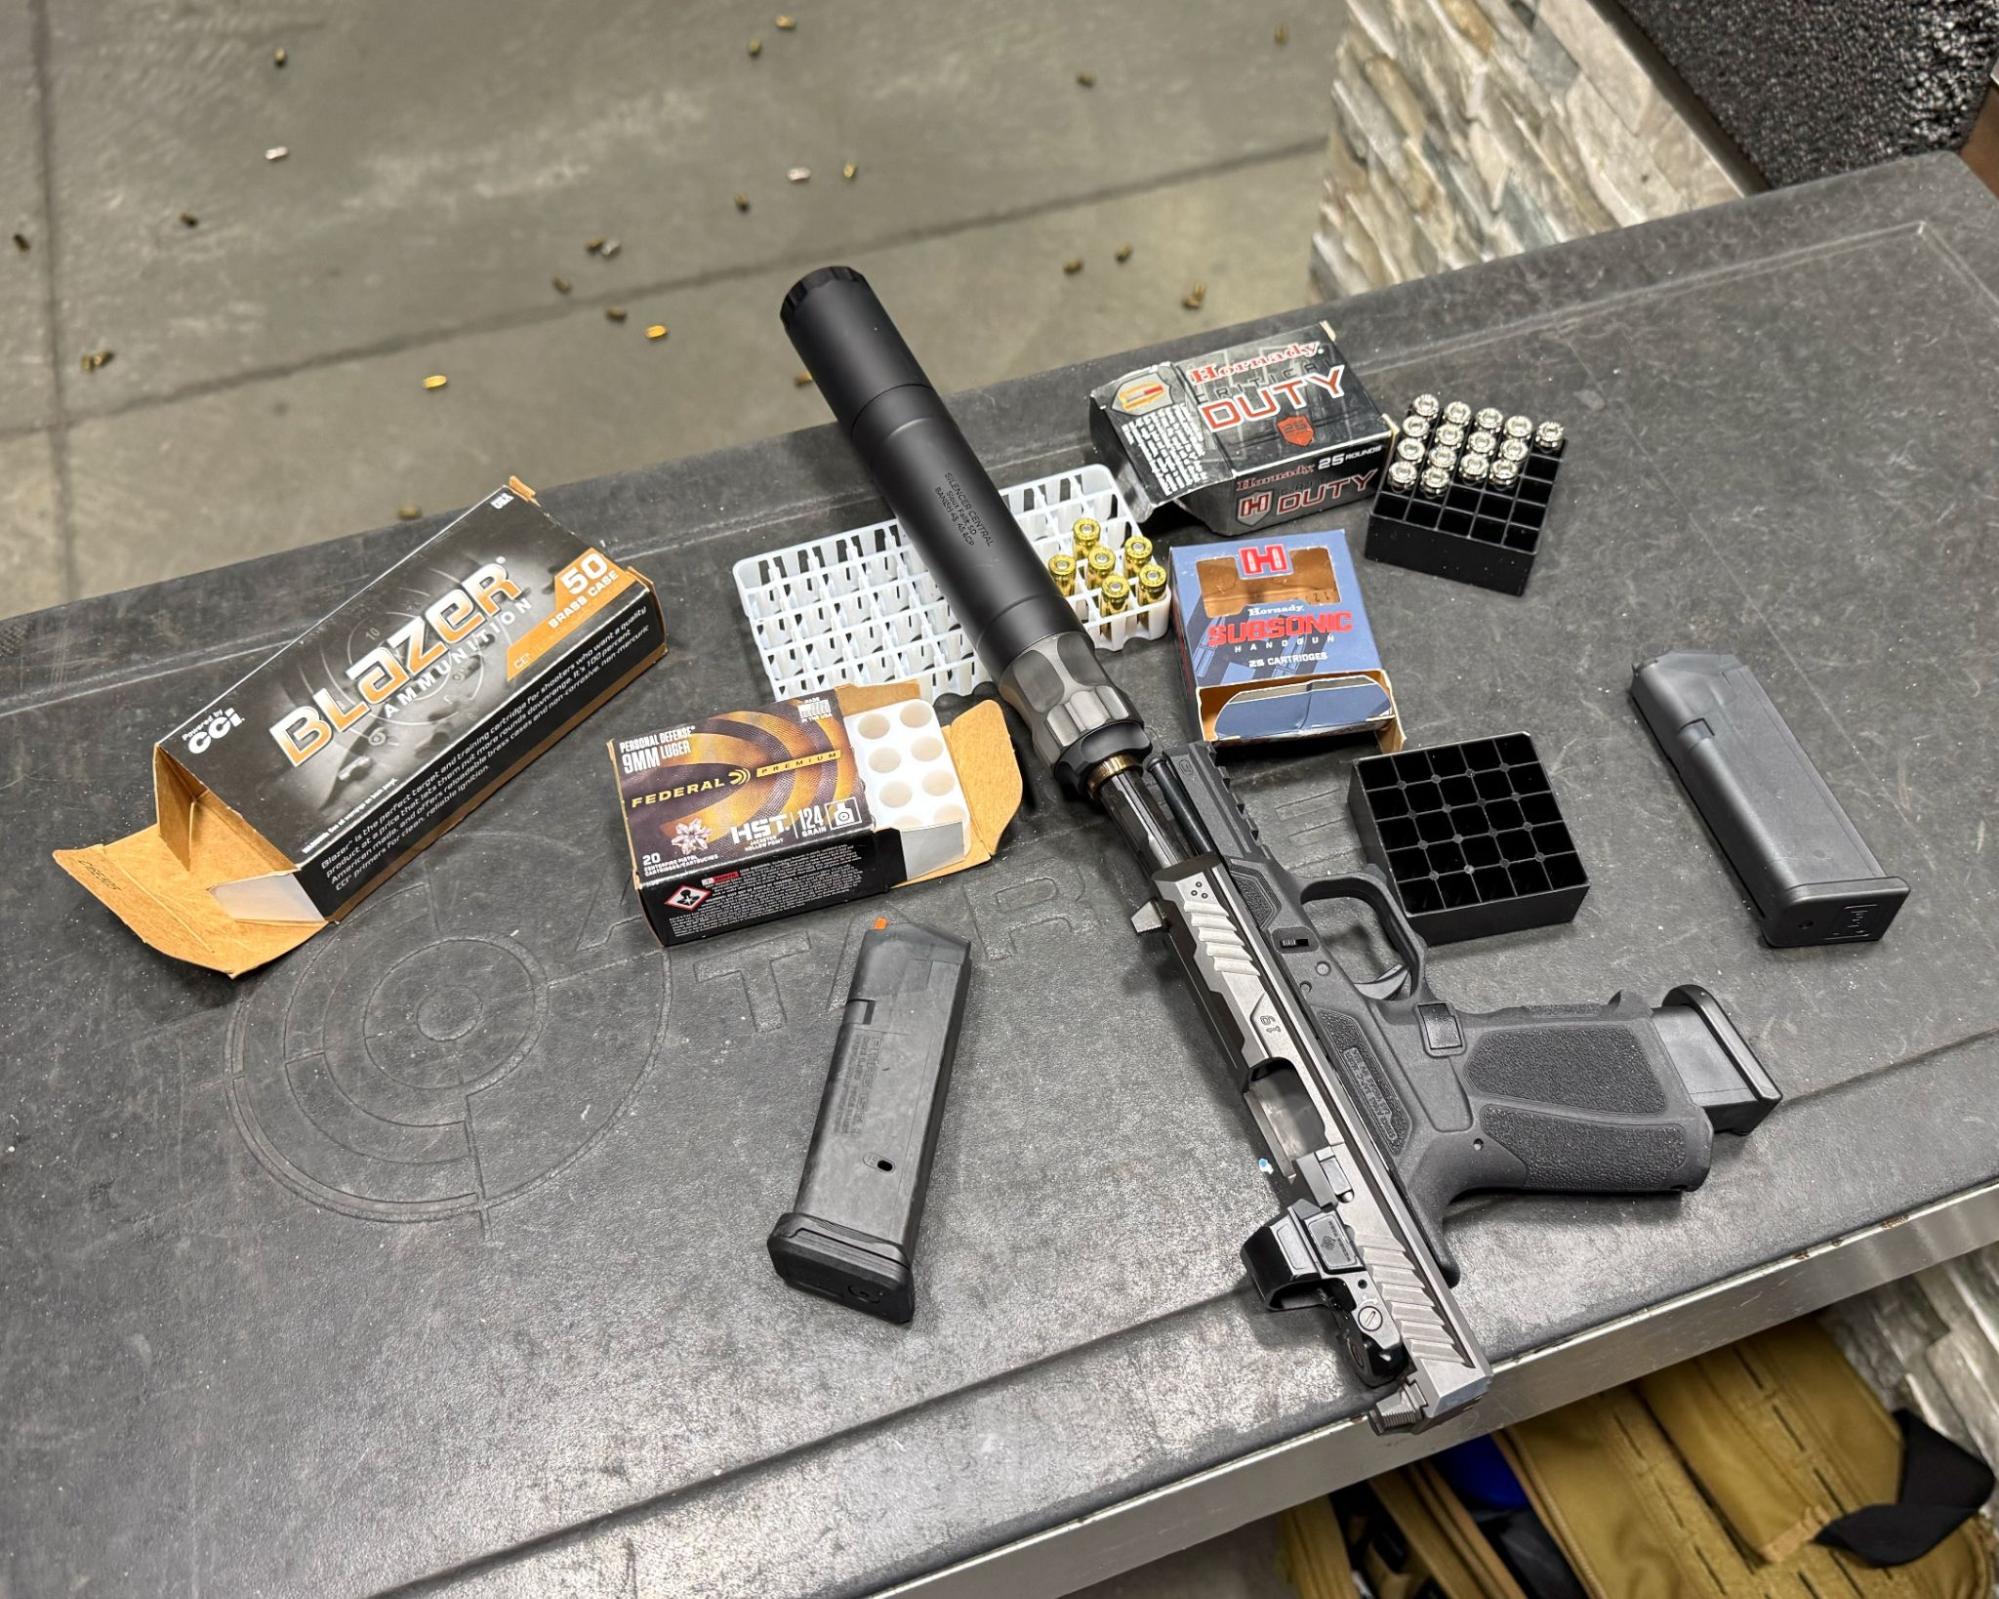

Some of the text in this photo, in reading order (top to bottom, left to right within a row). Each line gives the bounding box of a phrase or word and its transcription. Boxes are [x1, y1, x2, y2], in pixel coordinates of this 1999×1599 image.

[1186, 341, 1320, 384] Hornady
[1199, 364, 1345, 432] DUTY
[1317, 453, 1345, 470] 25
[1277, 469, 1378, 515] DUTY
[969, 511, 993, 547] CENTRAL
[559, 552, 607, 594] 50
[548, 569, 619, 628] BRASS CASE
[1247, 603, 1304, 617] Hornady
[1207, 612, 1353, 647] SUBSONIC
[1234, 635, 1335, 653] HANDGUN
[383, 597, 531, 718] AMMUNITION
[1267, 652, 1328, 666] CARTRIDGES
[181, 709, 225, 740] Powered by
[362, 820, 378, 835] the
[379, 793, 411, 823] perfect
[411, 771, 439, 796] target
[440, 756, 456, 773] and
[456, 731, 489, 759] training
[490, 701, 526, 733] cartridge
[527, 691, 539, 704] for
[540, 663, 575, 693] shooters
[575, 649, 593, 665] who
[593, 631, 614, 650] want
[620, 606, 646, 630] quality
[326, 846, 360, 878] product
[378, 814, 399, 835] price
[400, 798, 419, 816] that
[420, 784, 437, 800] lets
[437, 766, 460, 786] them
[461, 753, 475, 769] put
[476, 735, 498, 755] more
[499, 713, 526, 737] rounds
[587, 651, 601, 666] 100
[601, 628, 630, 656] percent
[619, 725, 693, 753] PERSONAL DEFENSE
[660, 740, 691, 760] LUGER
[622, 748, 661, 774] 9MM
[761, 751, 839, 775] PREMIUM
[331, 847, 372, 884] American
[399, 810, 415, 828] and
[416, 790, 443, 814] offers
[443, 755, 486, 792] reloadable
[487, 738, 509, 757] brass
[510, 719, 532, 739] cases
[532, 705, 548, 721] and
[631, 778, 725, 809] FEDERAL
[353, 847, 386, 878] primers
[386, 834, 400, 848] for
[426, 789, 457, 816] reliable
[731, 814, 788, 844] HST
[800, 808, 825, 833] 124
[801, 824, 827, 839] GRAIN
[642, 851, 660, 866] 20
